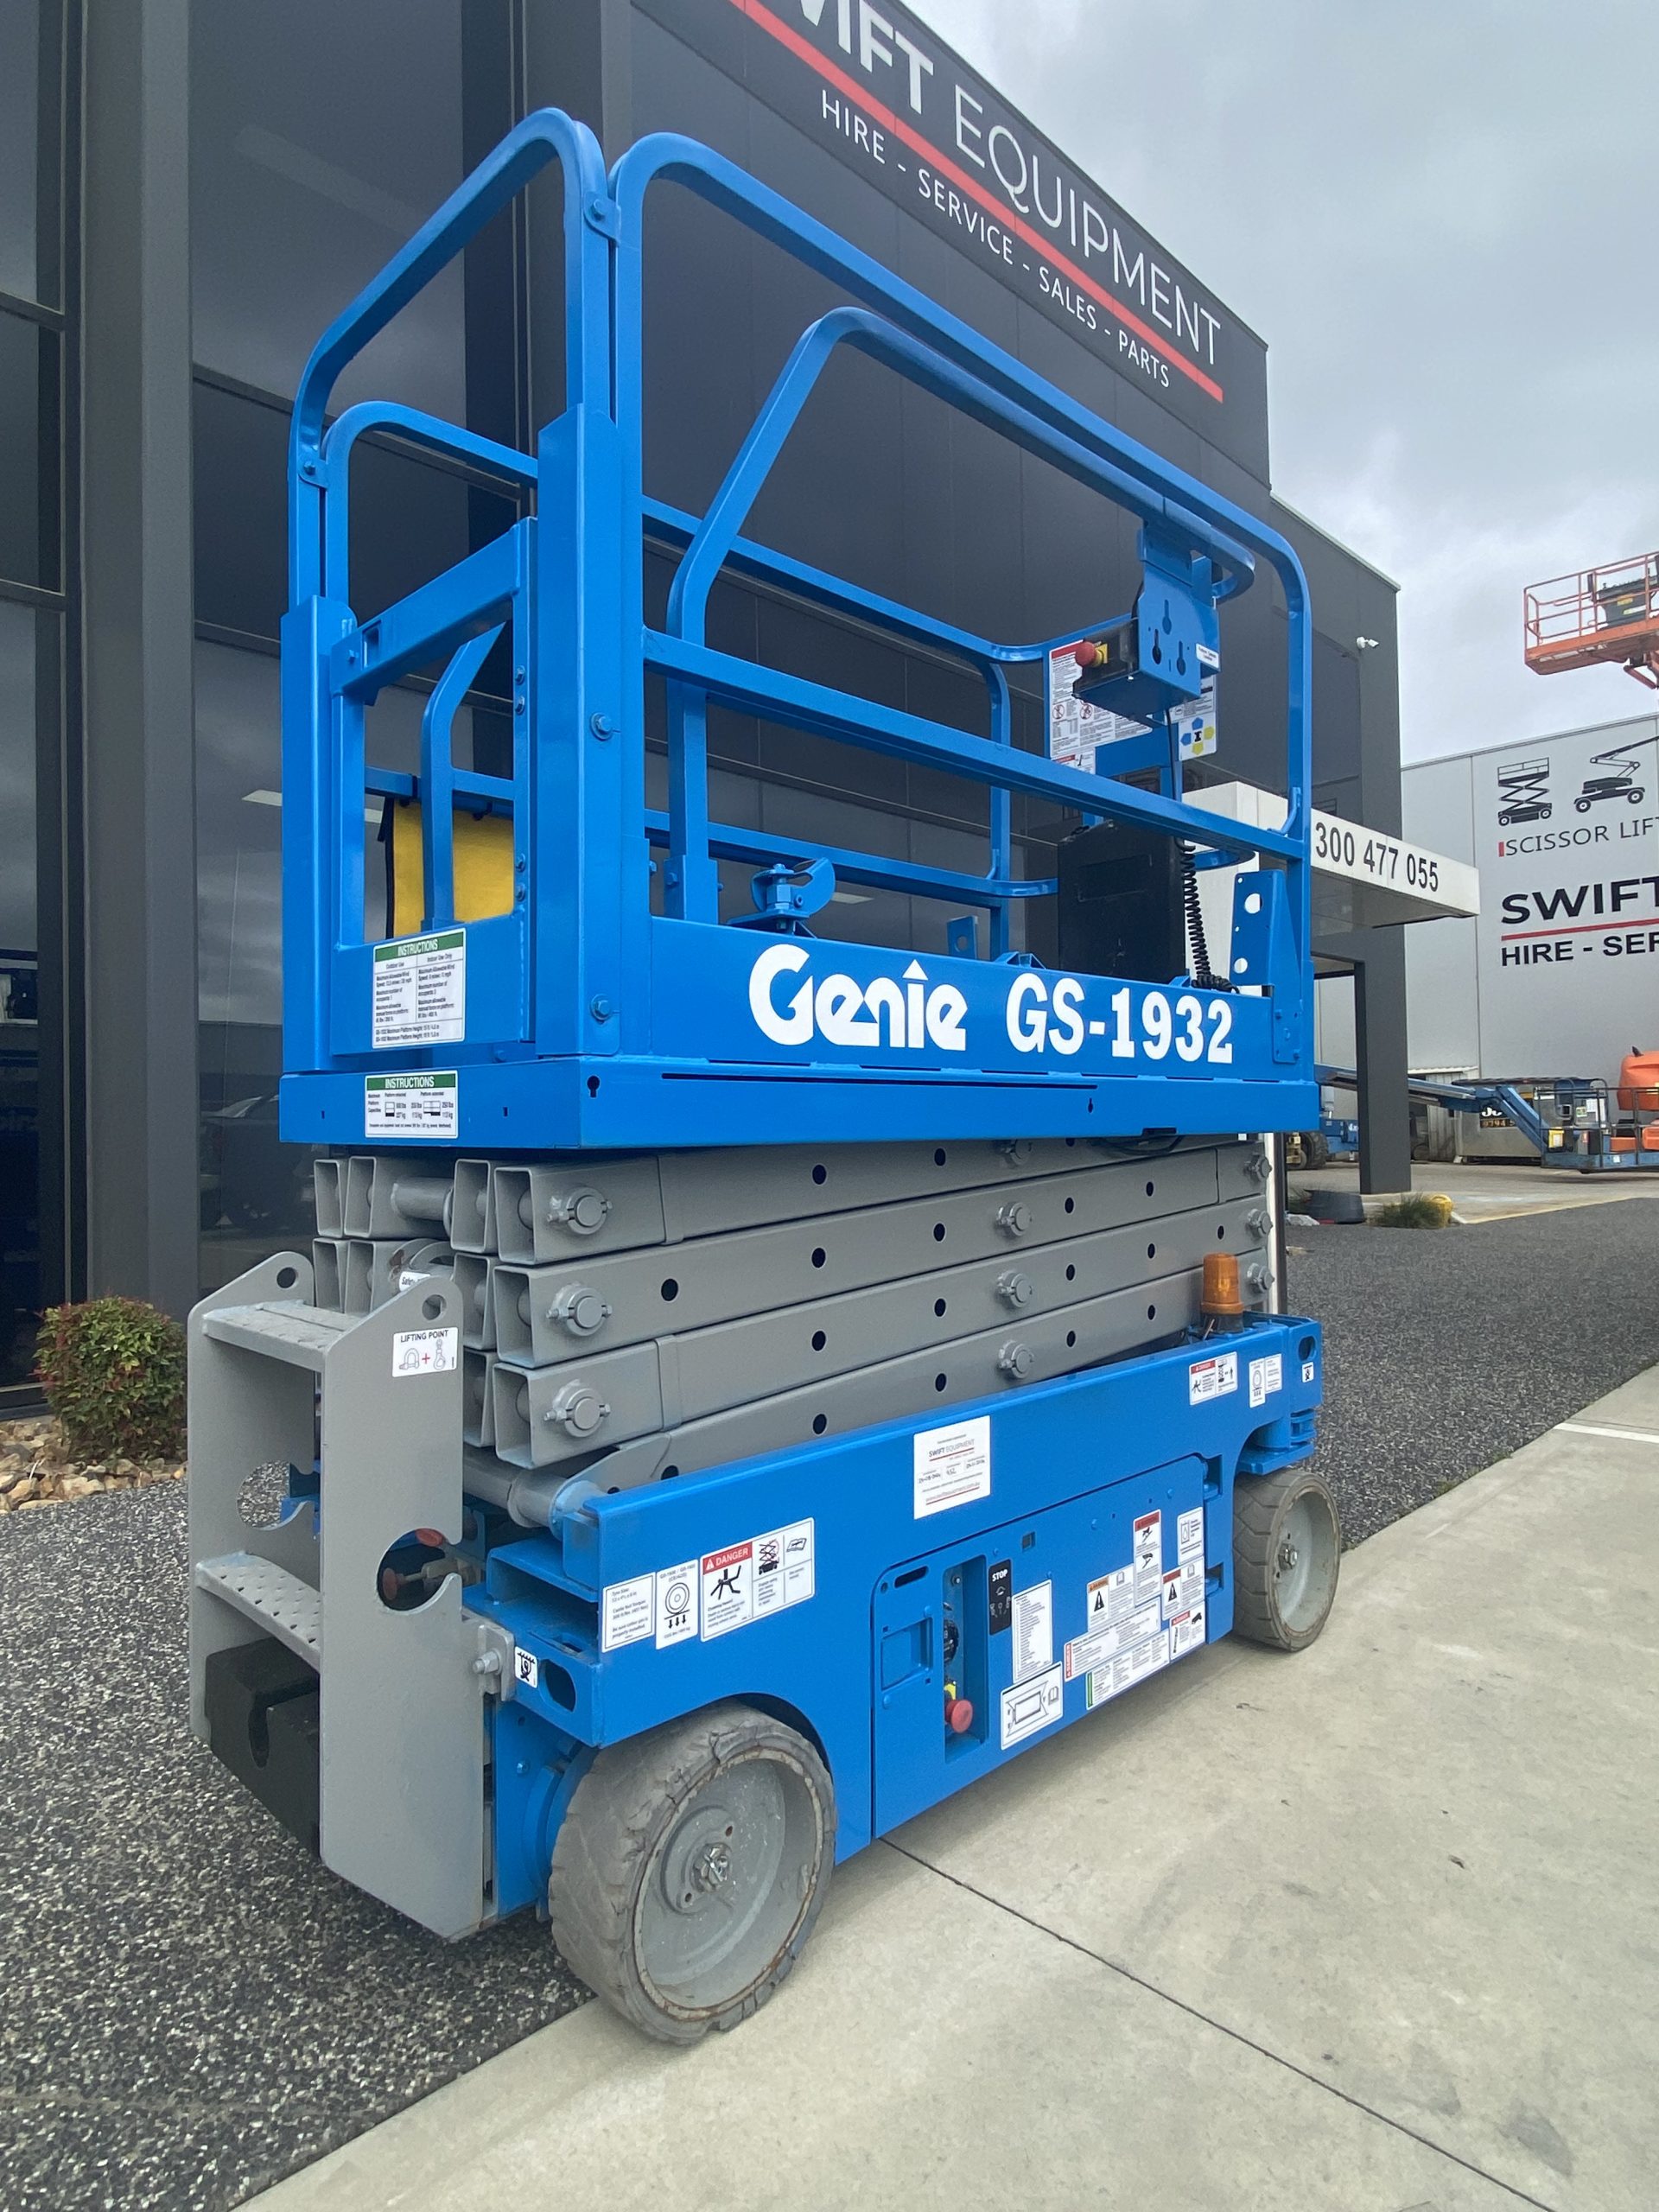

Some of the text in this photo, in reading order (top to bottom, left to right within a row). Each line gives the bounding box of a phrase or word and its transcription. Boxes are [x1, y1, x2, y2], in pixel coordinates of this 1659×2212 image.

[800, 0, 1220, 365] IFT EQUIPMENT
[822, 90, 885, 164] HIRE
[918, 168, 1013, 265] SERVICE
[1039, 266, 1096, 330] SALES
[1119, 330, 1169, 387] PARTS
[1506, 826, 1609, 855] SCISSOR
[1315, 822, 1439, 892] 300 477 055
[1501, 876, 1659, 924] SWIFT
[397, 938, 438, 956] INSTRUCTIONS
[1502, 940, 1573, 966] HIRE
[749, 944, 1233, 1064] Genie GS-1932
[385, 1077, 435, 1089] INSTRUCTIONS
[401, 1330, 448, 1343] LIFTING POINT
[715, 1547, 748, 1566] DANGER
[992, 1569, 1007, 1581] STOP
